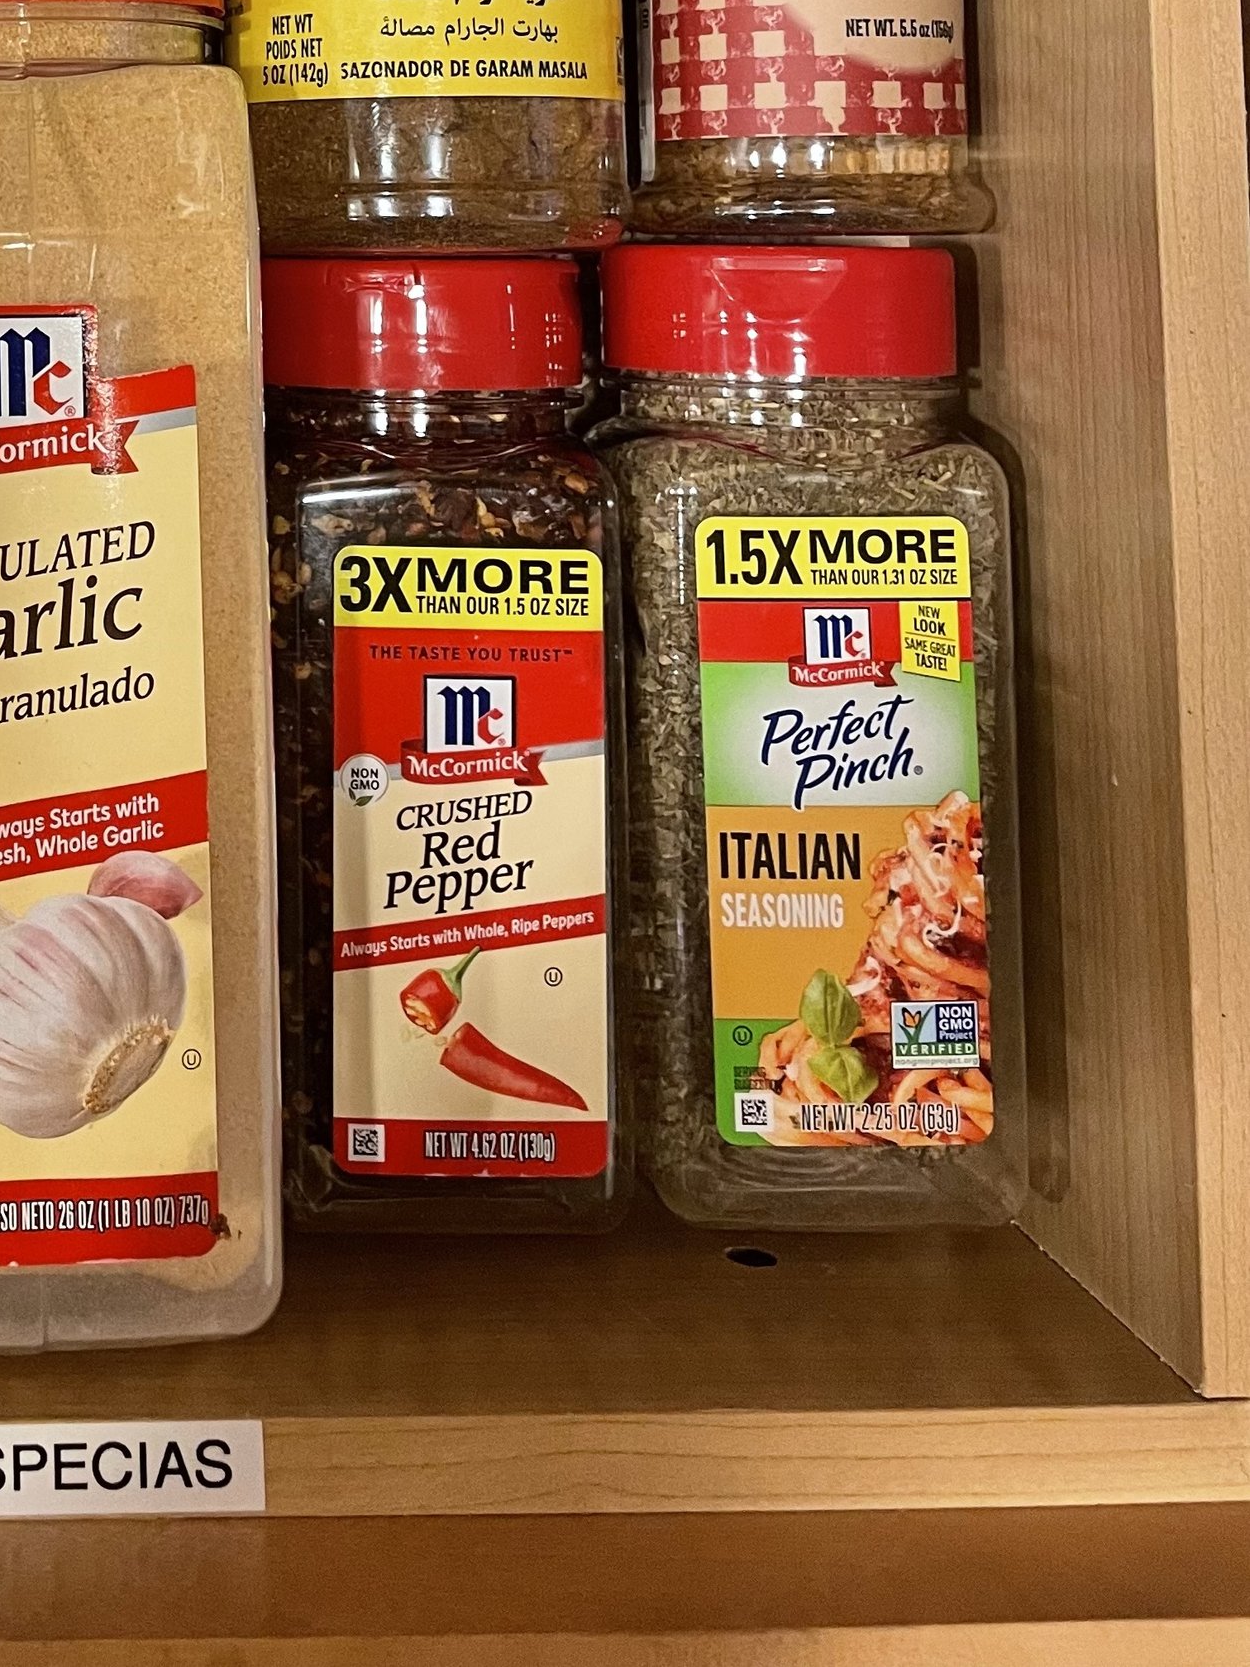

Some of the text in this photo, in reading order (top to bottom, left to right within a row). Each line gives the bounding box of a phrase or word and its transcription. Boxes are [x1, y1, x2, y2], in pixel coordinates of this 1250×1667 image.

[707, 529, 956, 585] 1.5X MORE
[340, 556, 589, 613] 3X MORE
[914, 619, 946, 635] LOOK
[918, 605, 940, 618] NEW
[791, 664, 884, 684] McCormick
[761, 694, 914, 765] Perfect
[407, 752, 528, 778] McCormick
[794, 727, 913, 810] Pinch
[50, 803, 110, 829] Starts
[115, 794, 159, 819] with
[397, 790, 532, 830] CRUSHED
[36, 832, 98, 858] Whole
[103, 821, 164, 846] Garlic
[420, 820, 501, 869] Red
[719, 832, 861, 880] ITALIAN
[384, 859, 534, 914] Pepper
[721, 893, 843, 928] SEASONING
[939, 1007, 972, 1018] NON
[939, 1018, 973, 1031] GMO
[900, 1044, 974, 1055] VERIFIED
[939, 1030, 973, 1042] Project
[425, 1131, 555, 1161] NET WT 4.62 OZ (130g)
